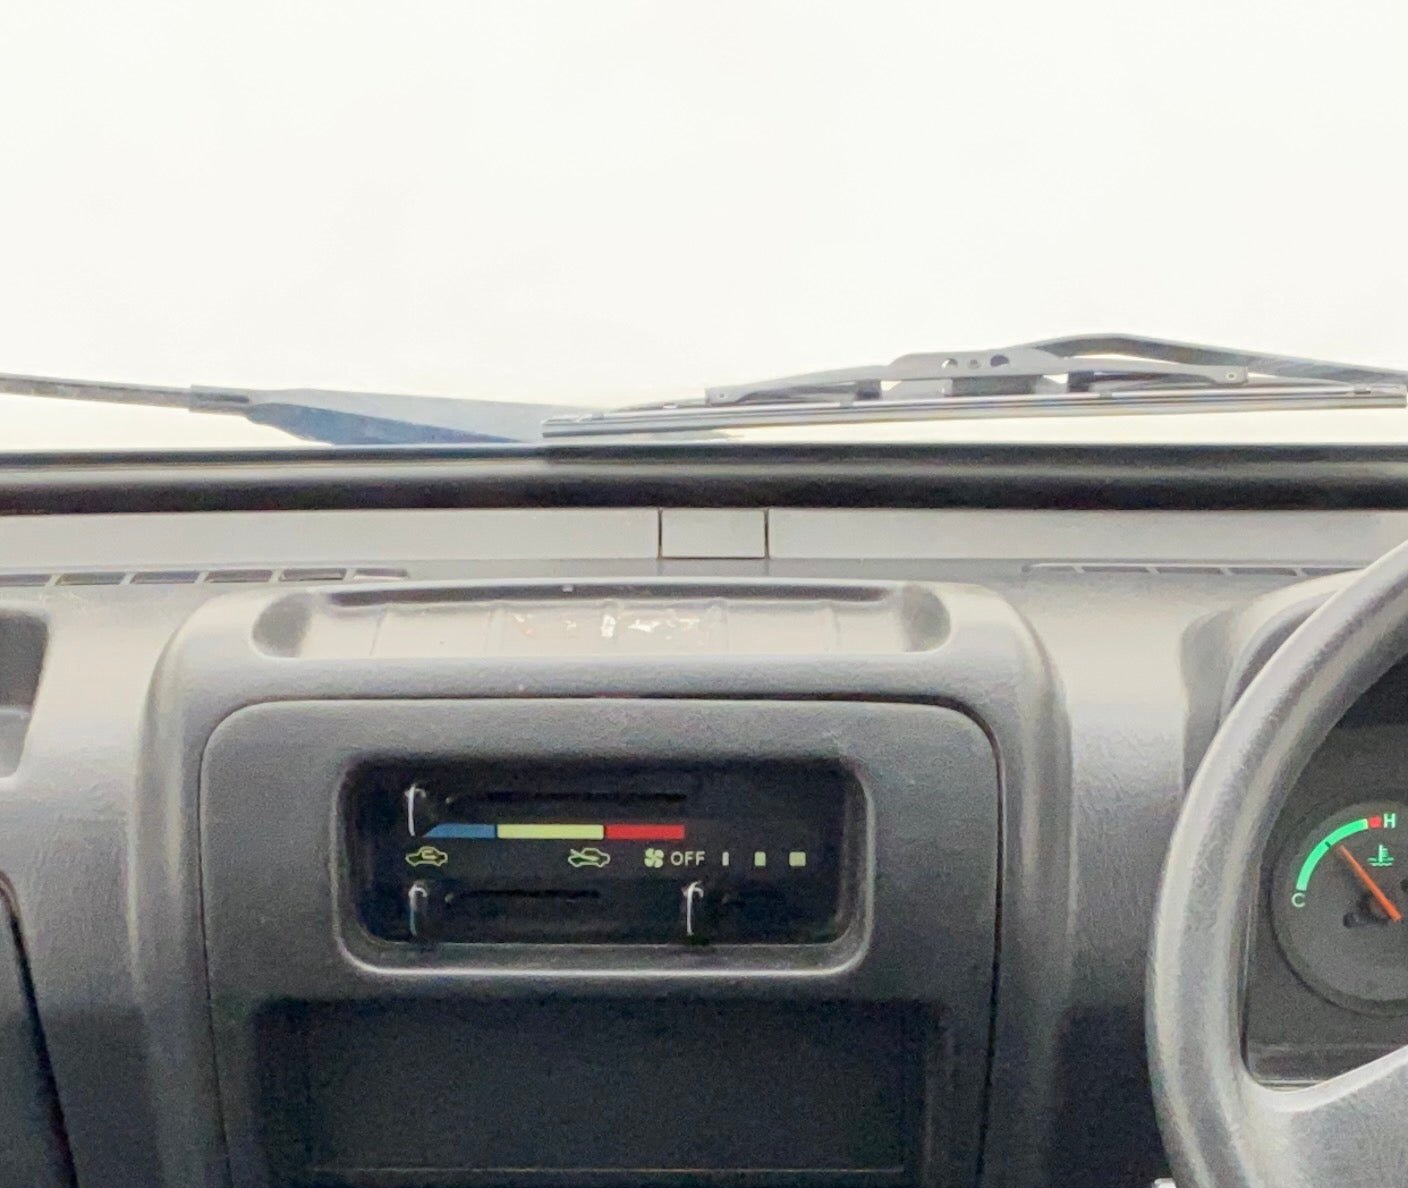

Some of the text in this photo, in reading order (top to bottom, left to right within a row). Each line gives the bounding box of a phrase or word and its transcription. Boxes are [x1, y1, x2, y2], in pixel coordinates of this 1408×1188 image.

[1383, 813, 1396, 828] H
[670, 850, 706, 866] OFF
[1292, 893, 1306, 908] C
